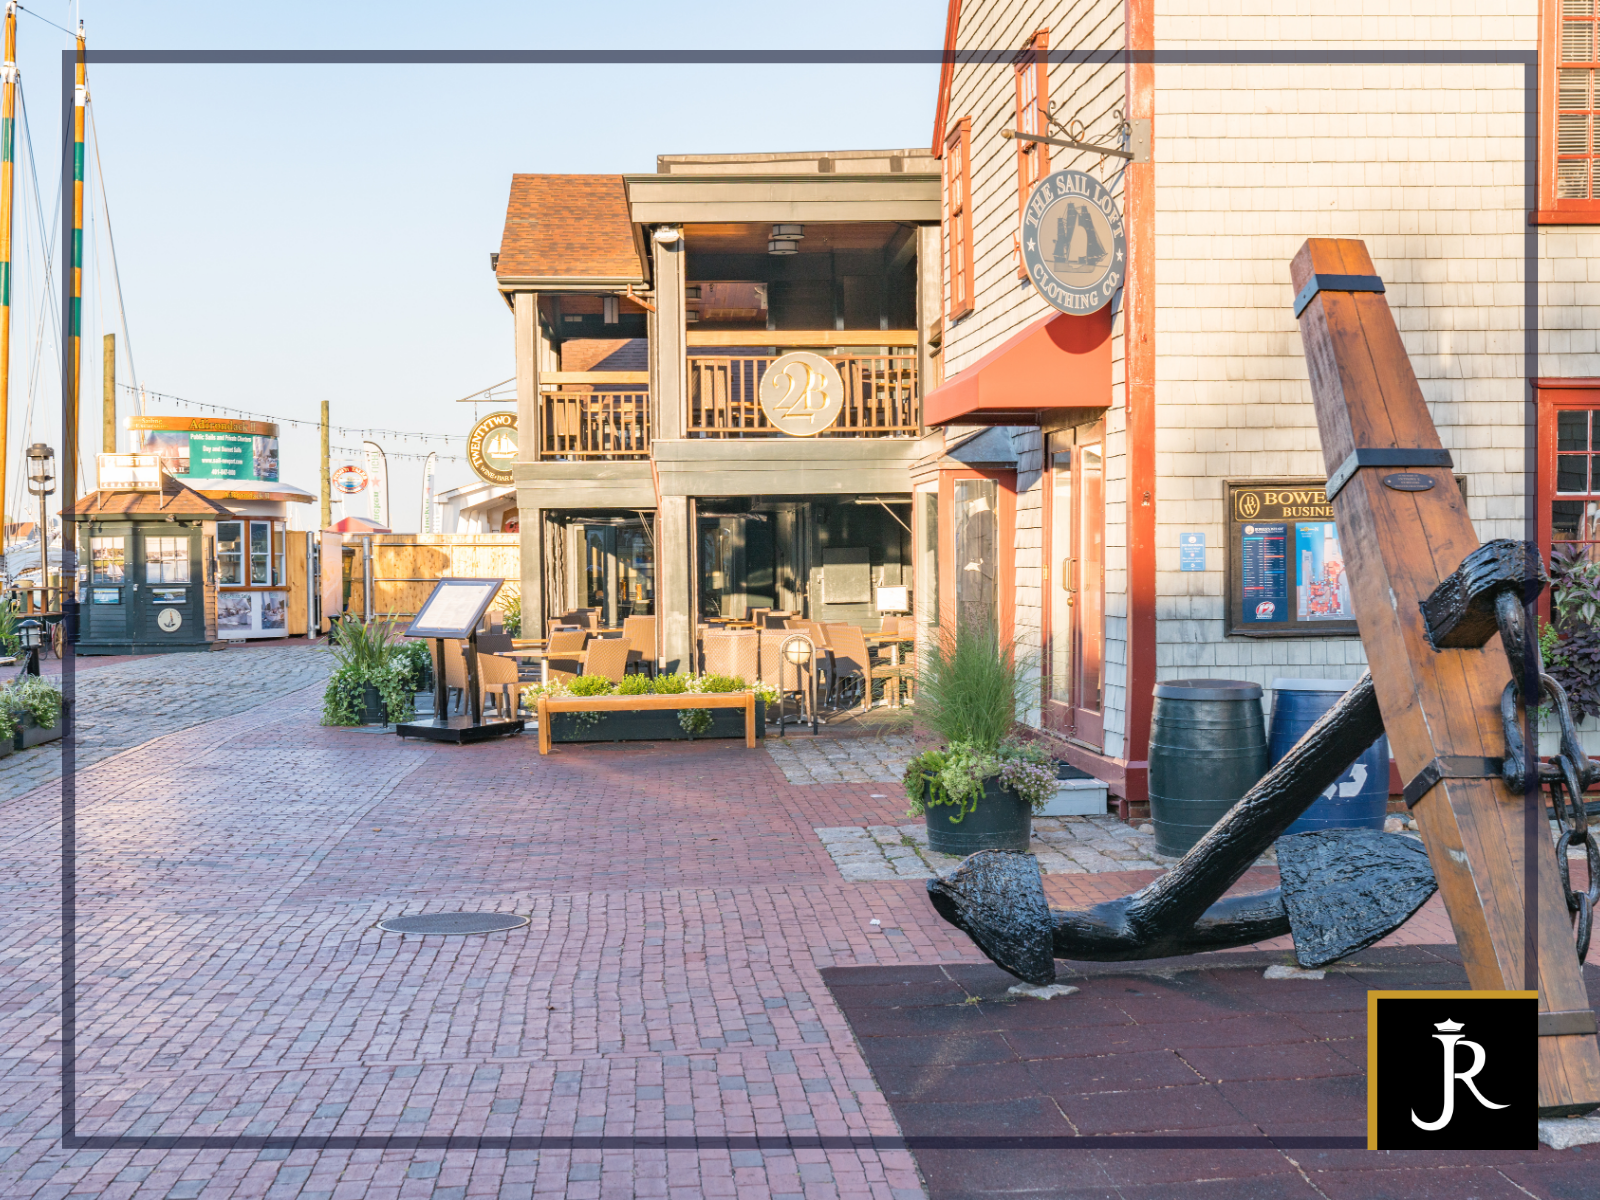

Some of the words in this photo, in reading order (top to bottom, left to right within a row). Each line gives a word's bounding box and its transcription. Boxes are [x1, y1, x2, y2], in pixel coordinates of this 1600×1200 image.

[1026, 183, 1054, 228] THE
[1056, 174, 1090, 195] SAIL
[1093, 184, 1124, 238] LOFT
[1034, 264, 1098, 310] CLOTHING
[189, 419, 248, 431] Adirondack
[470, 416, 511, 468] TWENTYTWO
[1264, 492, 1330, 505] BOWE
